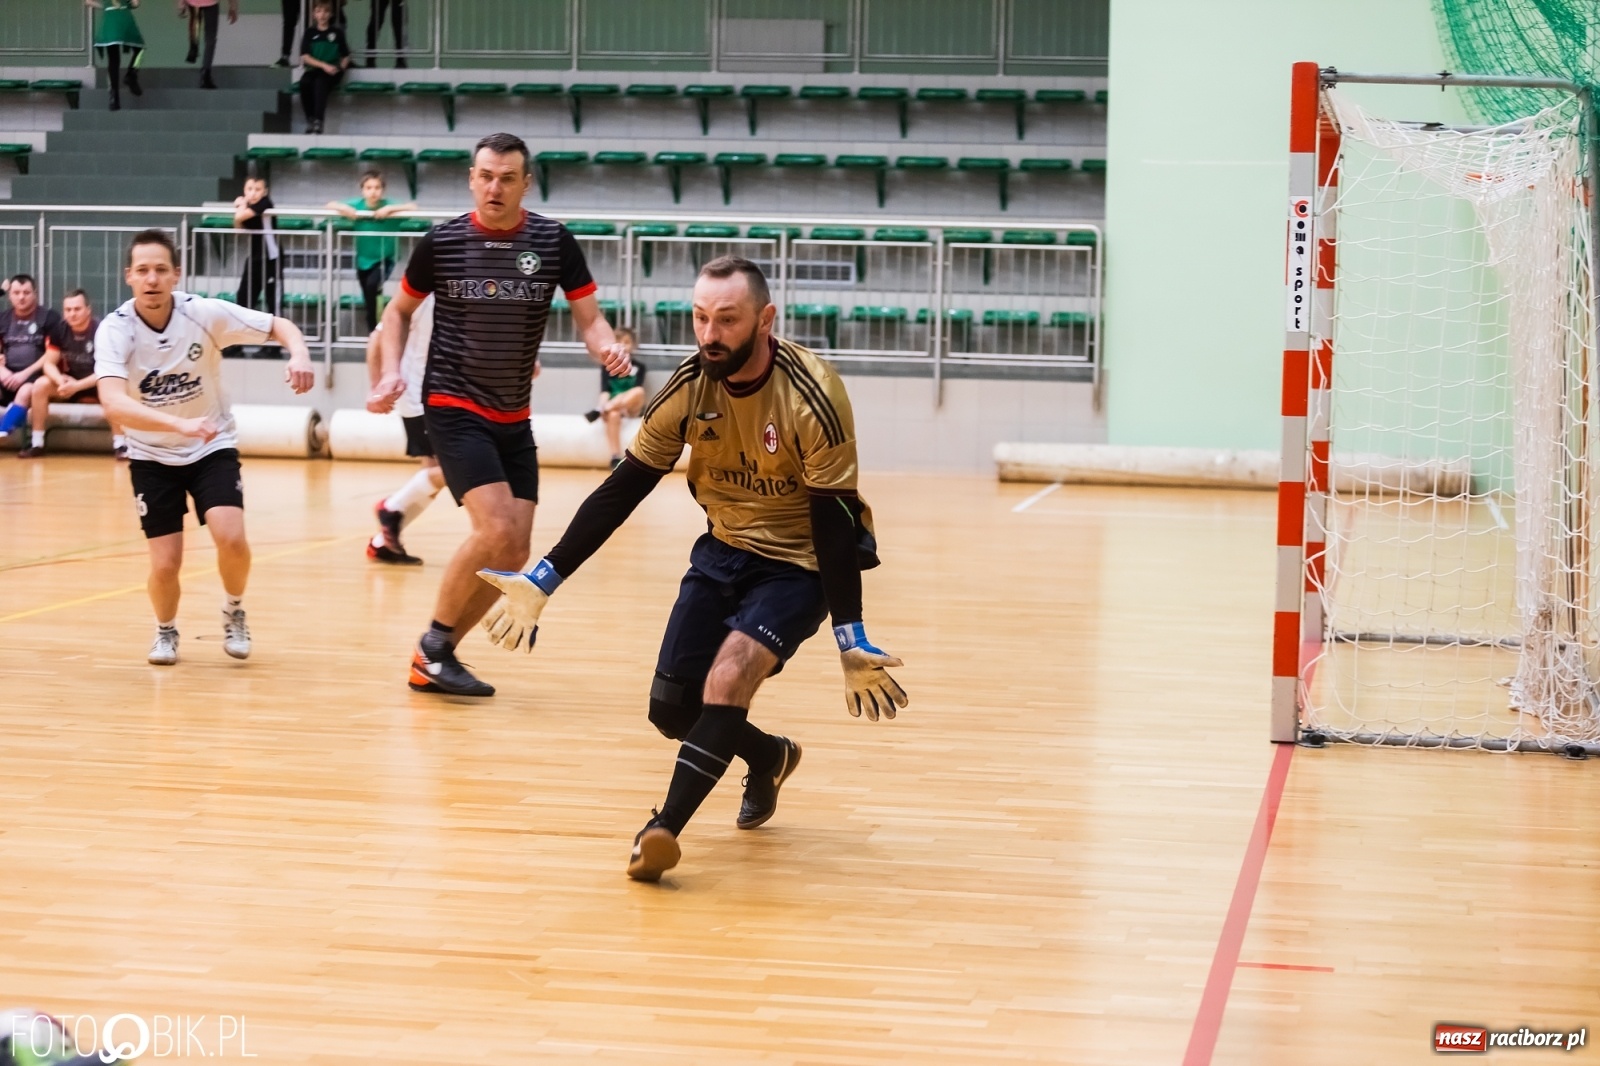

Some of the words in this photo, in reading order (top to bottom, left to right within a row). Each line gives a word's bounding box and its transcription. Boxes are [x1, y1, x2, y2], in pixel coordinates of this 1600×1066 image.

[446, 279, 549, 301] PROSAT
[1294, 267, 1304, 329] sport
[758, 625, 783, 647] KIPSTA
